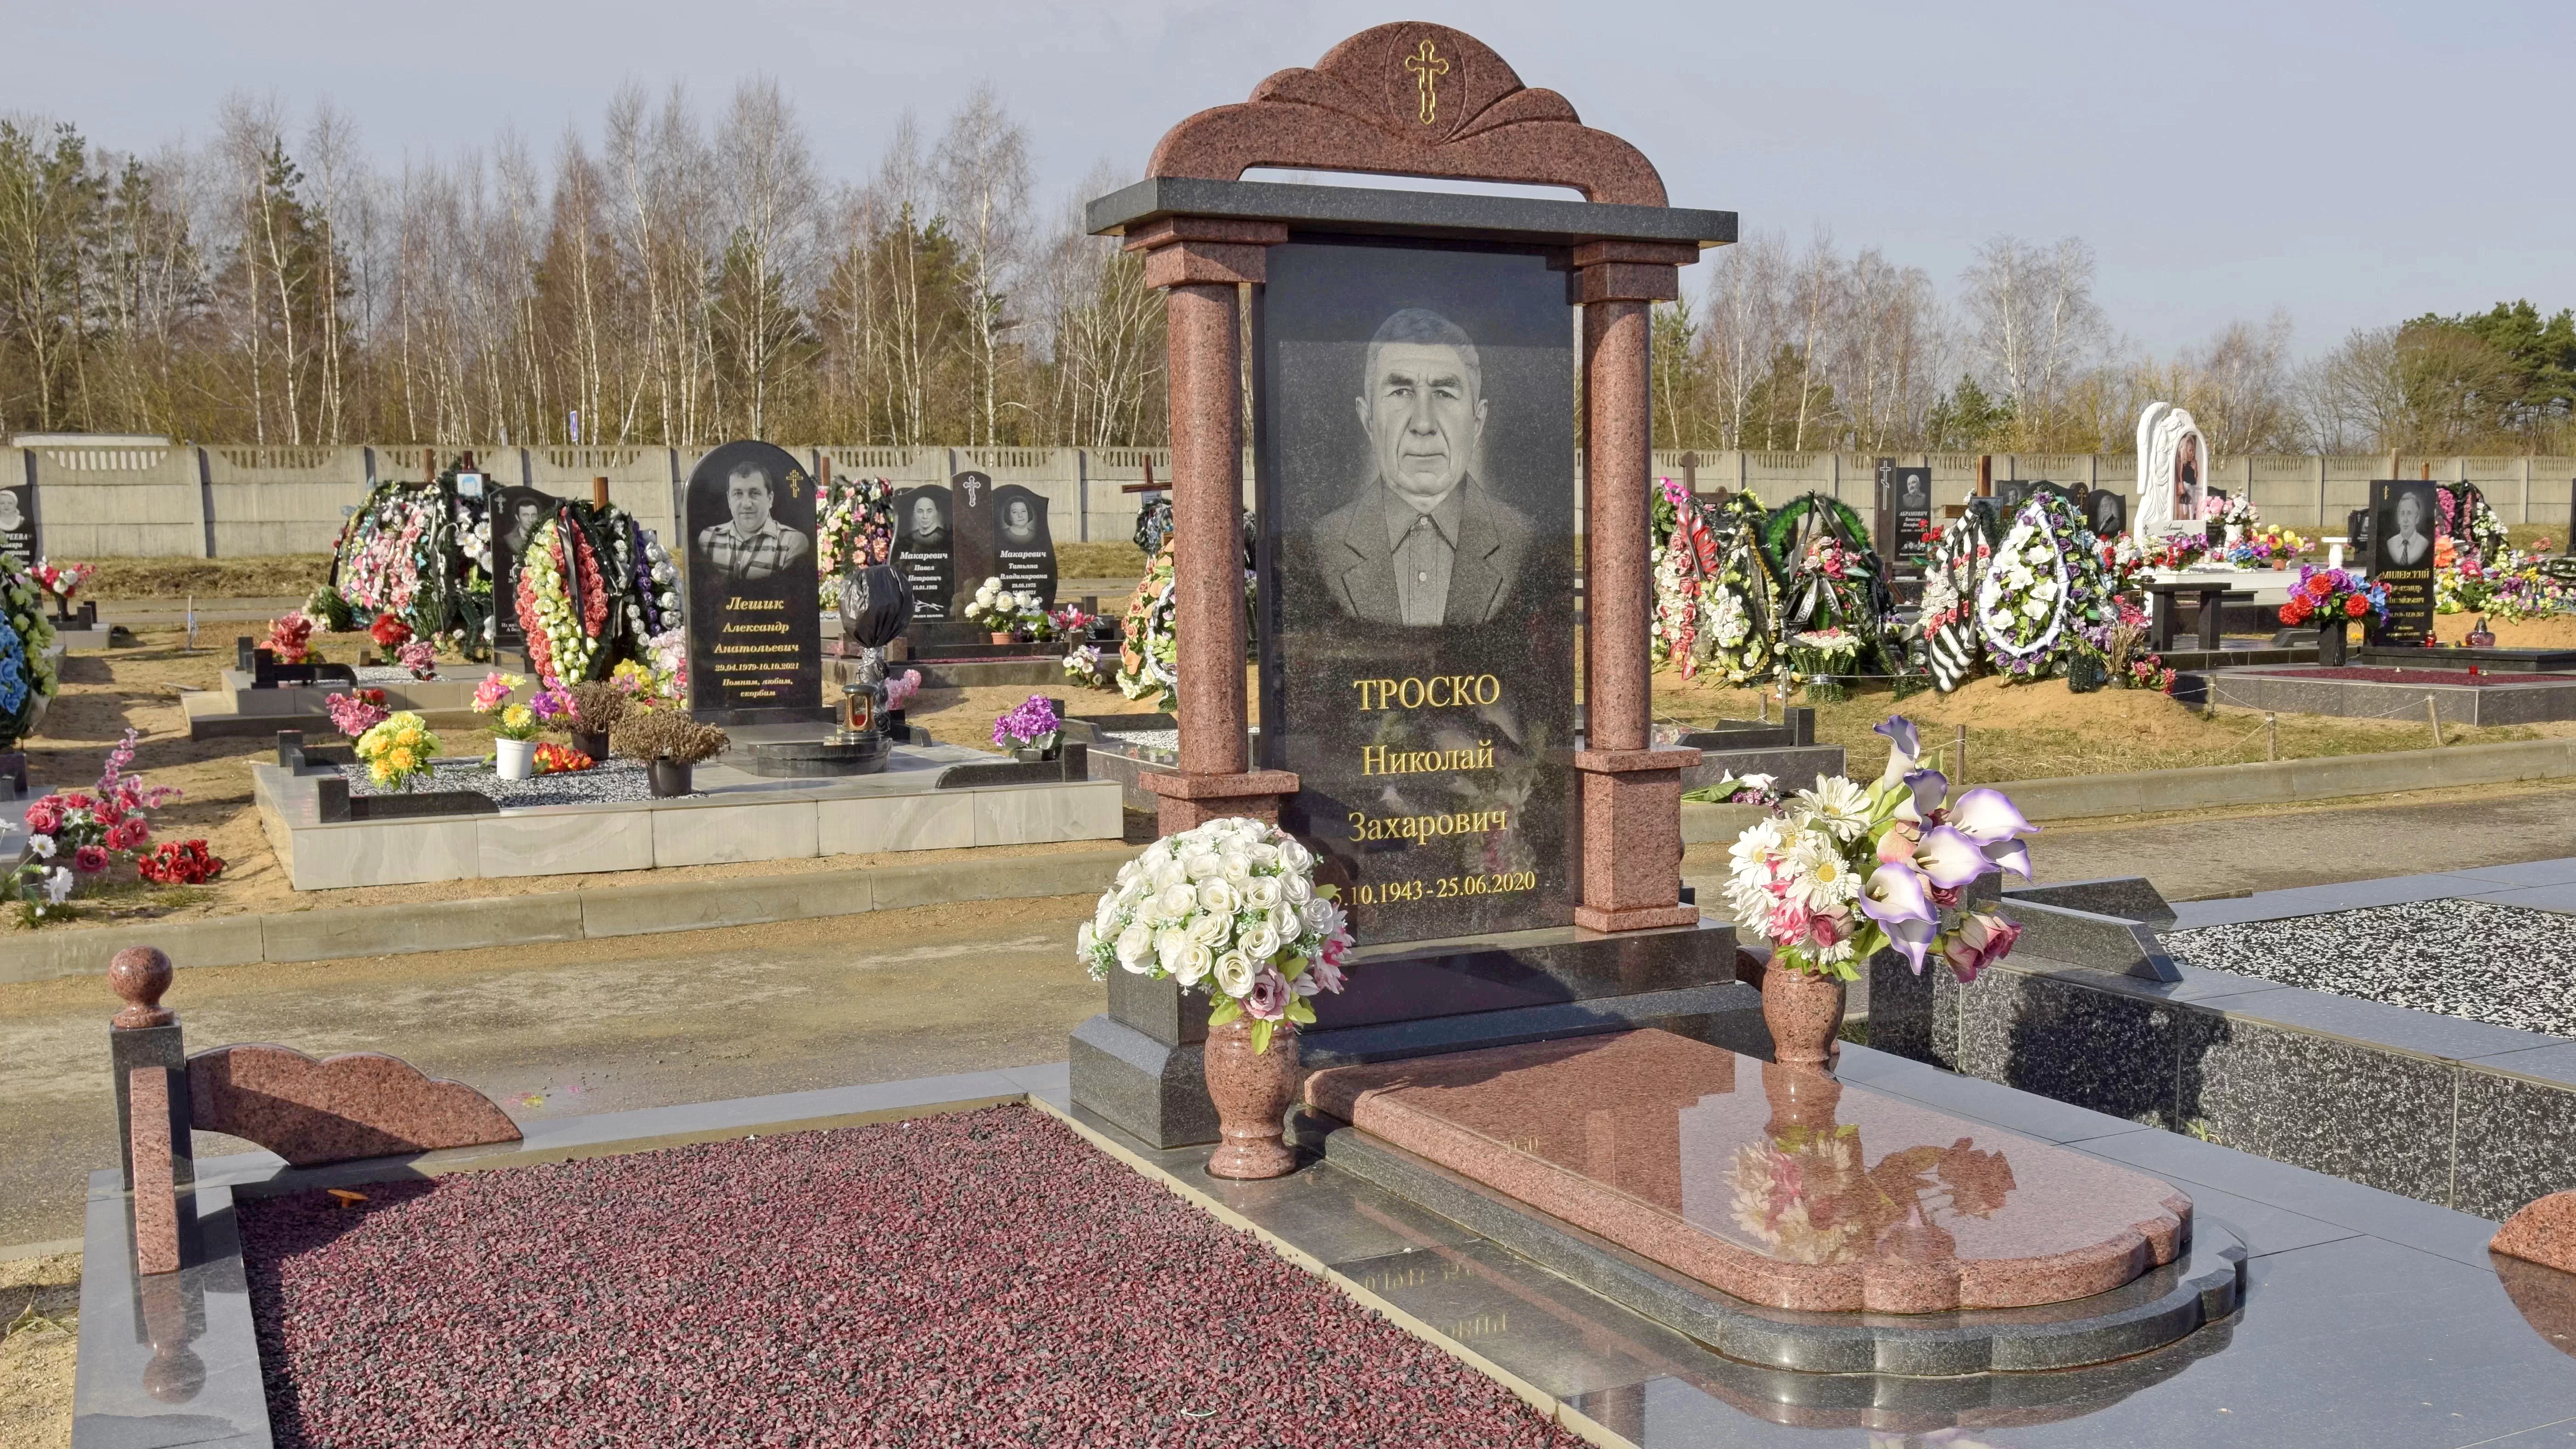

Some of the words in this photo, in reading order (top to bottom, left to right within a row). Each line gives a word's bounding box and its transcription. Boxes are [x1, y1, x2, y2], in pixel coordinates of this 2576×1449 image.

[900, 551, 948, 560] Макаревич
[1000, 550, 1047, 559] Макаревич
[726, 597, 785, 610] Лешик
[722, 621, 789, 634] Александр
[714, 643, 799, 654] Анатольевич
[715, 662, 799, 672] 29.04.1979-10.10.2021
[740, 689, 776, 698] скорбим
[1353, 674, 1500, 710] ТРОСКО
[1361, 739, 1495, 775] Николай
[1349, 811, 1508, 845] Захарович
[1336, 880, 1423, 906] 5.10.1943
